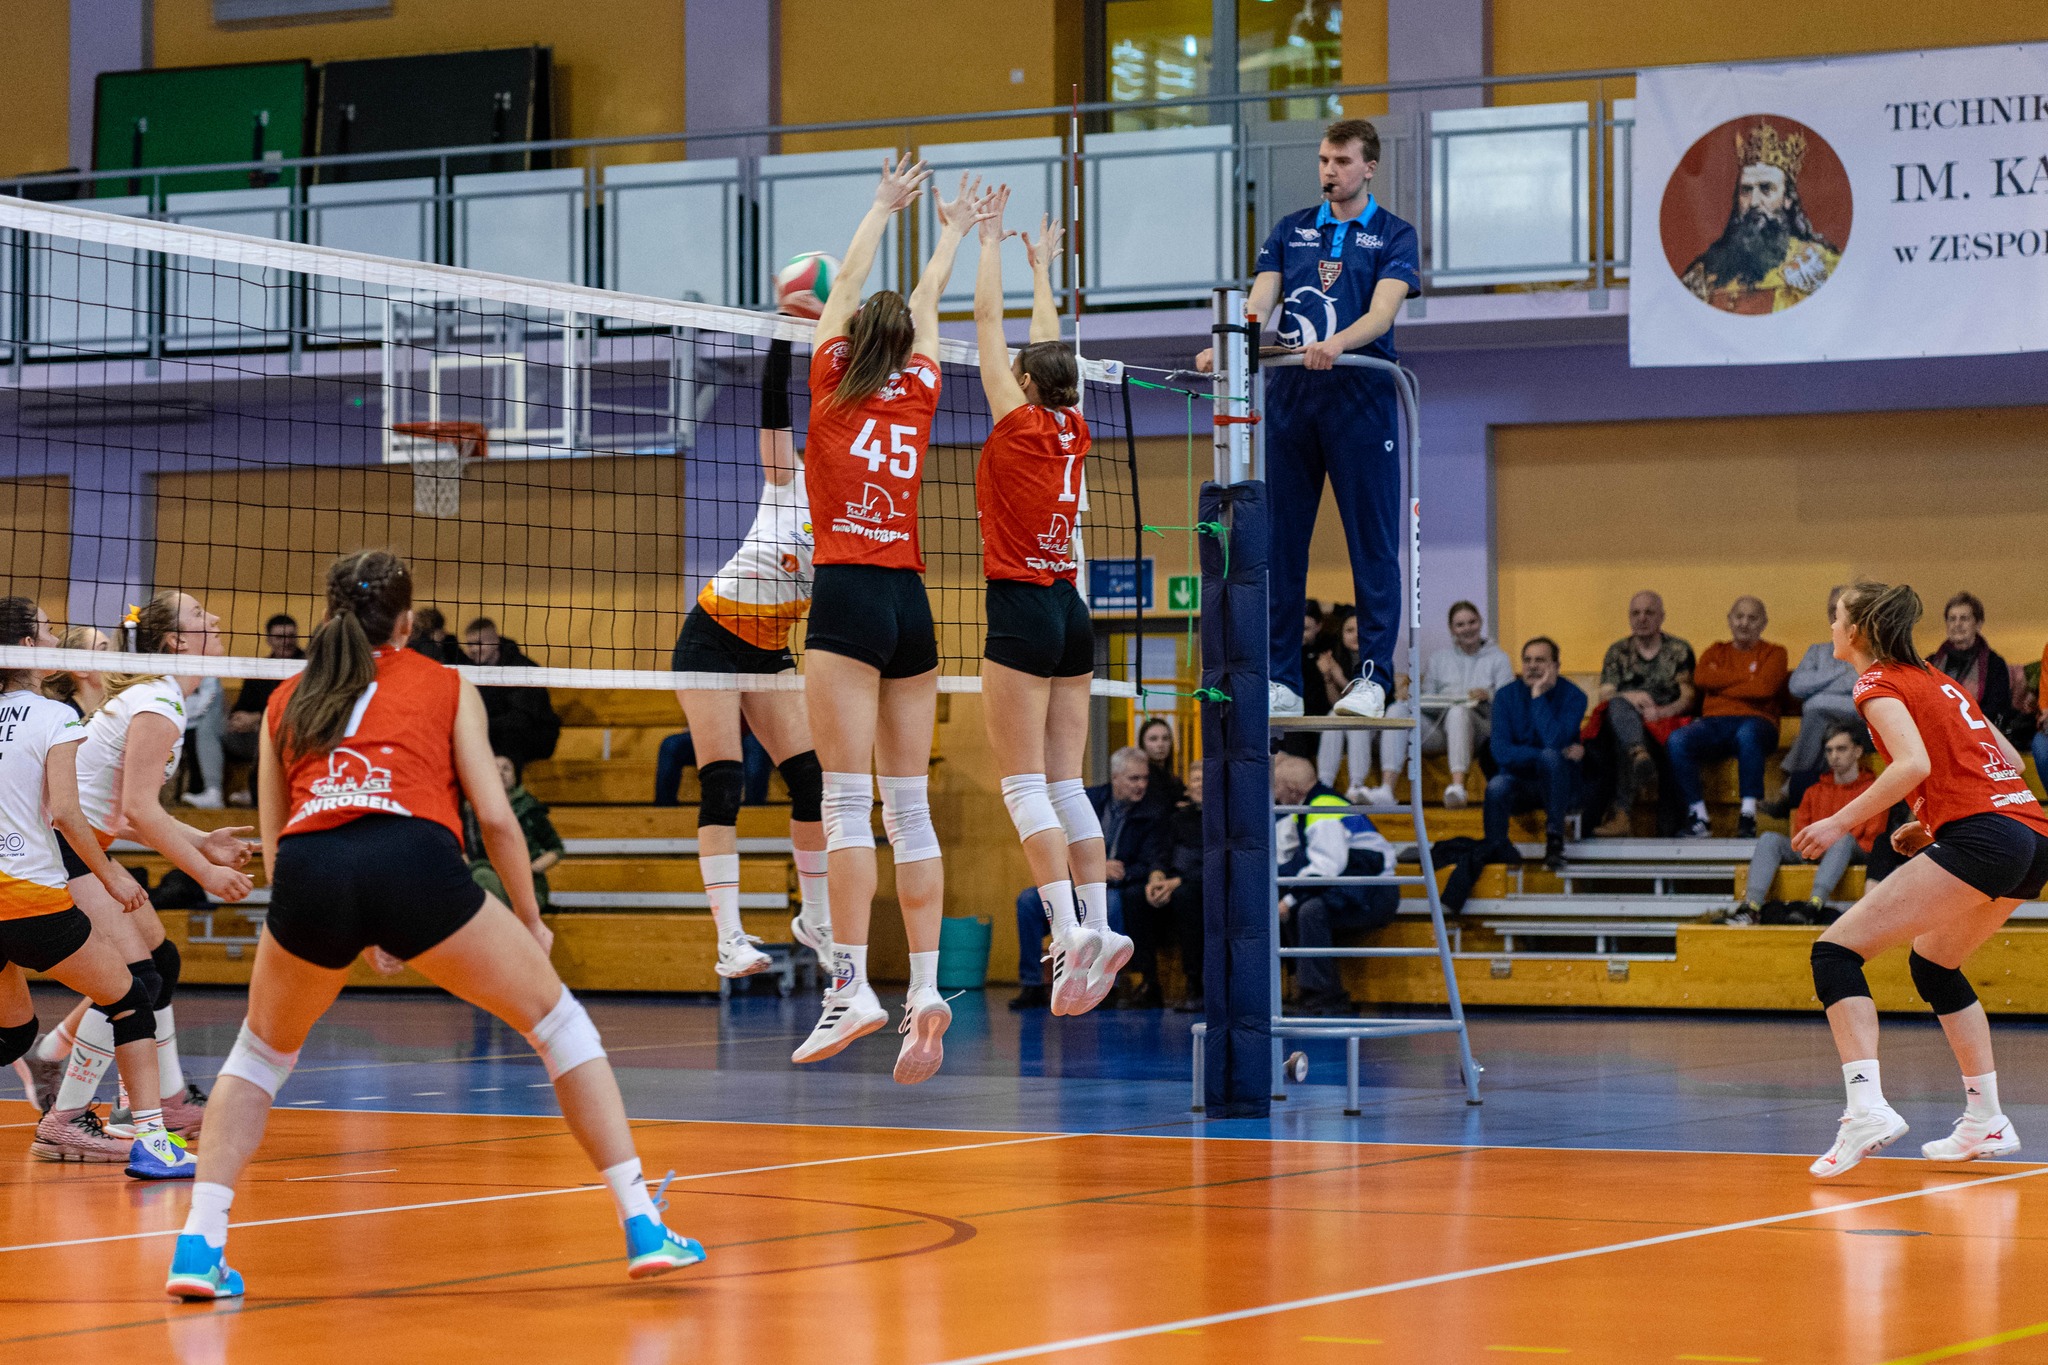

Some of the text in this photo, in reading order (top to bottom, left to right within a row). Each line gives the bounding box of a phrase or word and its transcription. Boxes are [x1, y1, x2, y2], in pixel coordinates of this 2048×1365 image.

[1890, 160, 1970, 203] IM.
[1893, 229, 2048, 264] w ZESPO
[849, 418, 918, 480] 45
[1057, 454, 1076, 502] 1
[1940, 684, 1987, 730] 2
